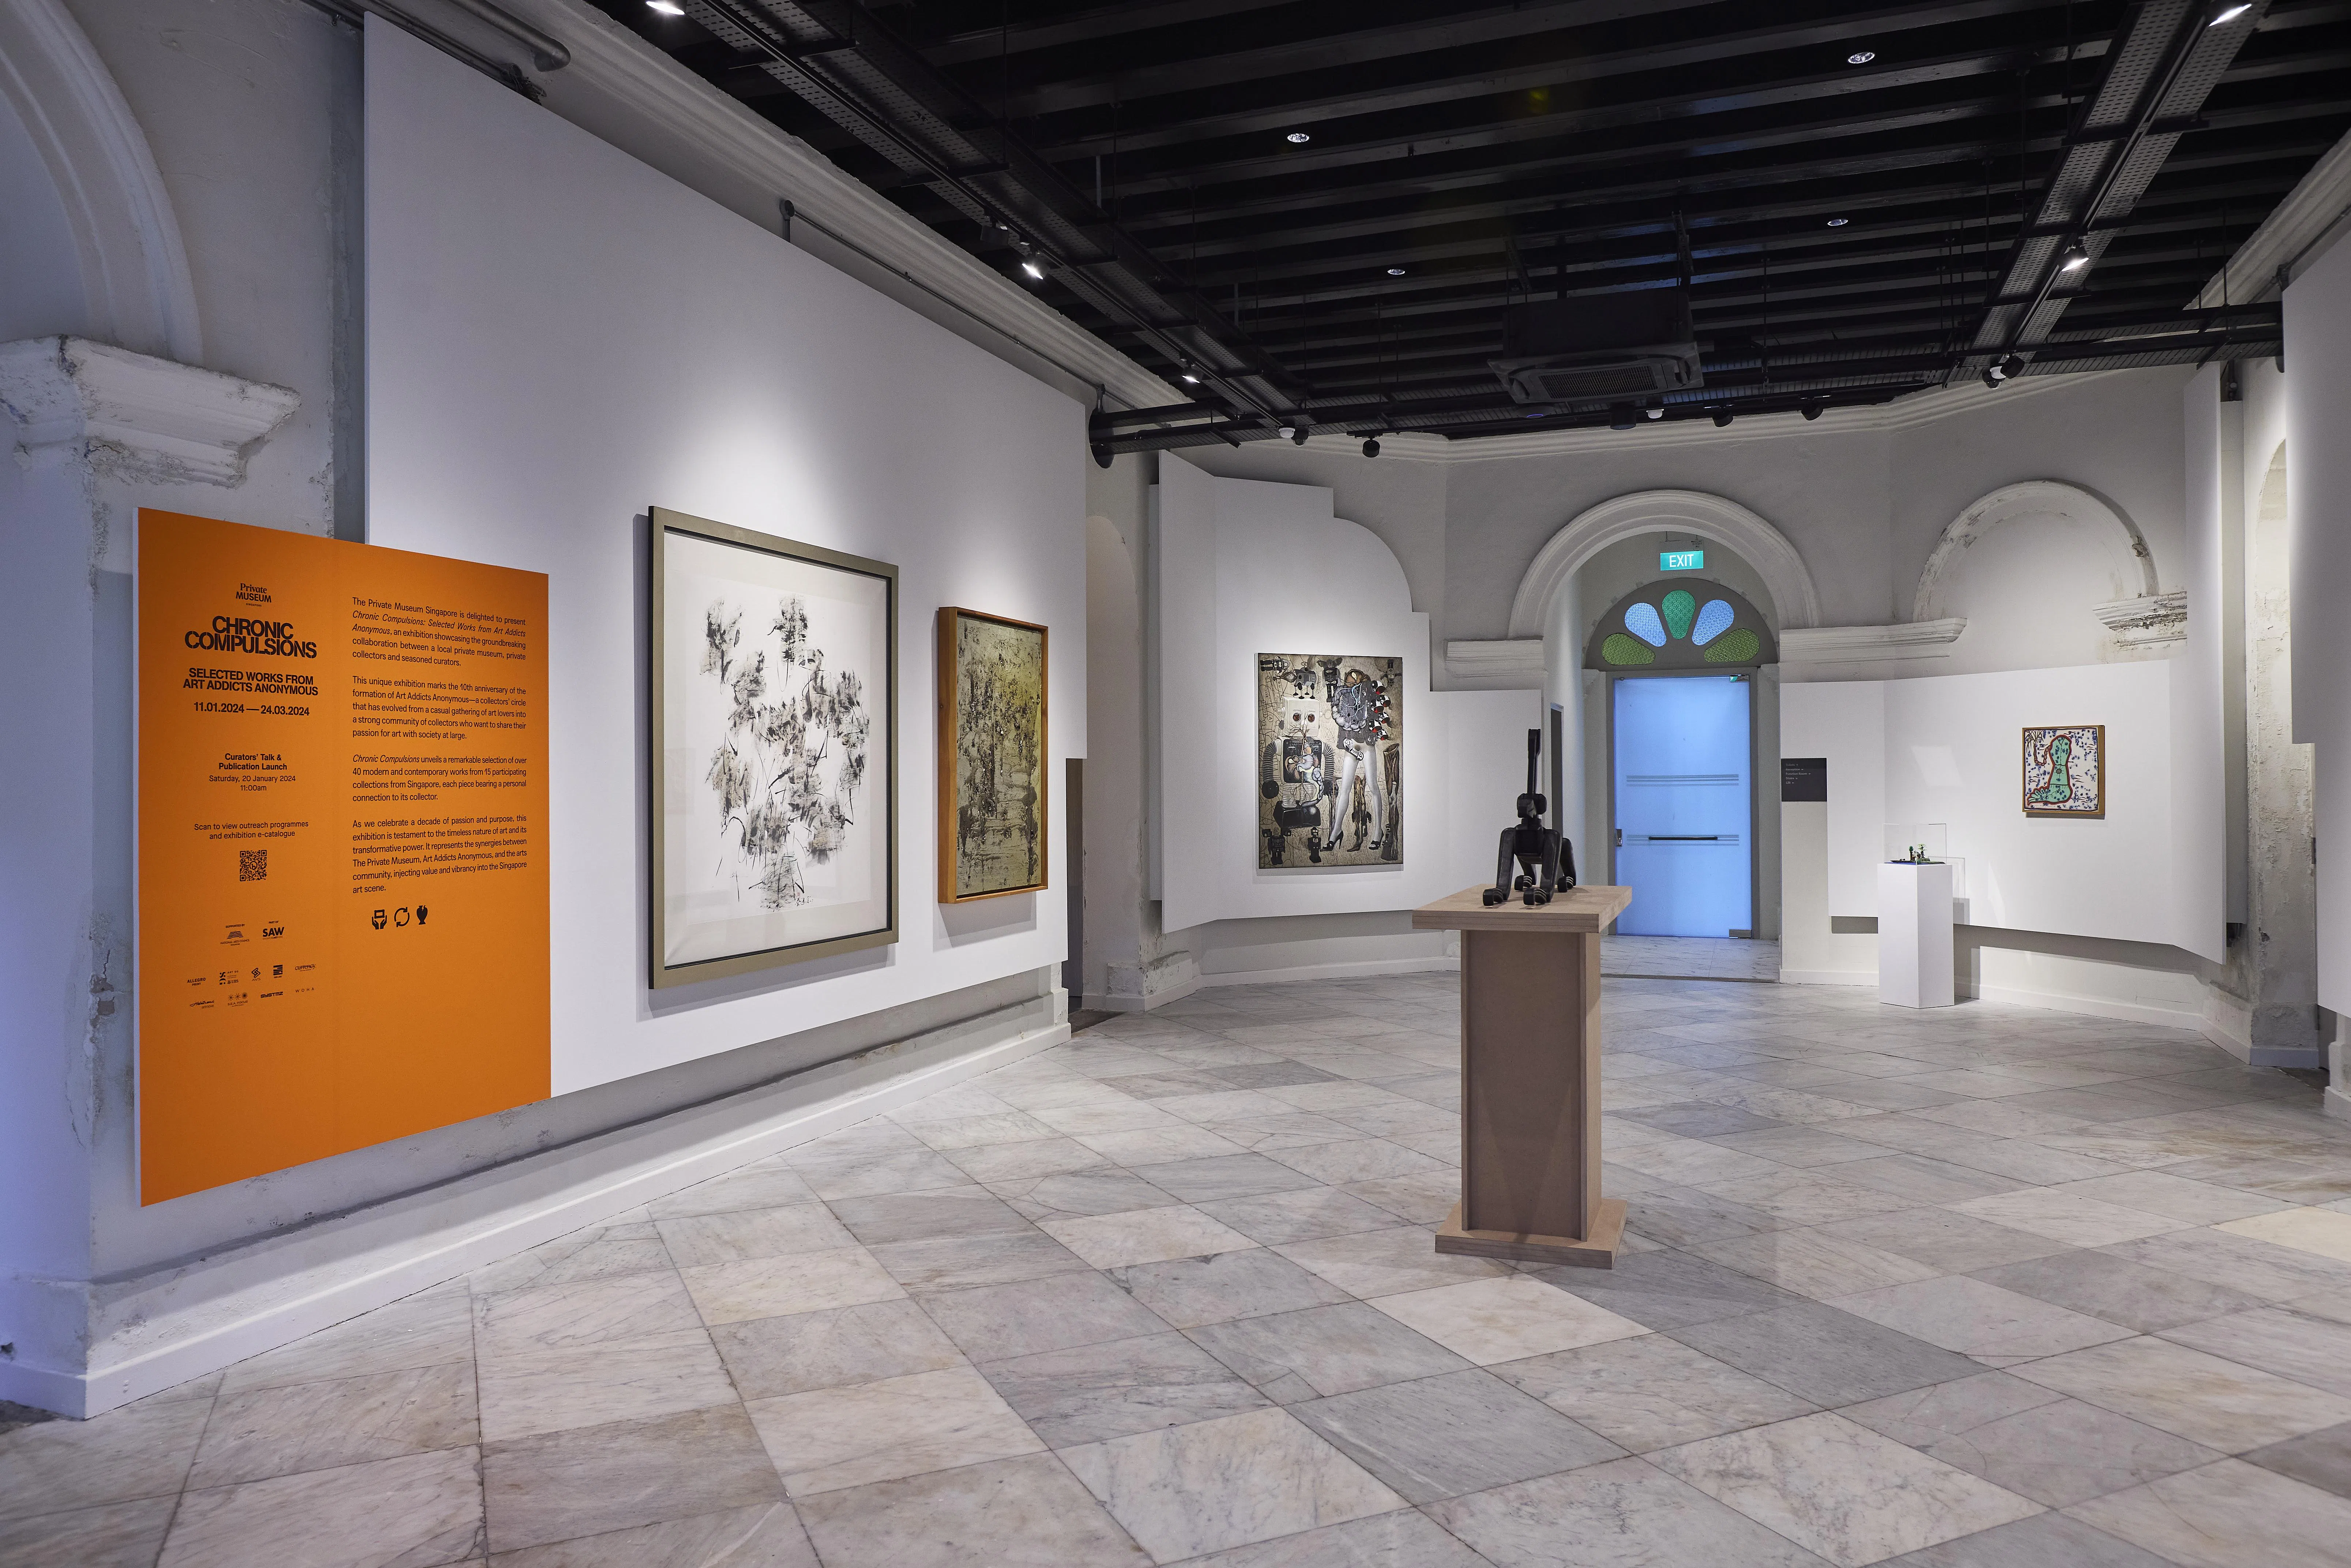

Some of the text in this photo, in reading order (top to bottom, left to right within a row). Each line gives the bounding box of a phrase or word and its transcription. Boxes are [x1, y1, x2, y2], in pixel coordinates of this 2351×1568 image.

[1669, 554, 1694, 567] EXIT
[240, 583, 267, 594] Private
[236, 591, 271, 603] MUSEUM
[352, 597, 365, 606] The
[369, 599, 392, 609] Private
[395, 602, 423, 613] Museum
[426, 606, 457, 617] Singapore
[467, 612, 494, 621] delighted
[212, 616, 293, 640] CHRONIC
[353, 610, 379, 620] Chronic
[383, 614, 425, 625] Compulsions:
[428, 619, 455, 629] Selected
[458, 623, 475, 631] Works
[505, 628, 526, 637] Addicts
[352, 624, 392, 635] Anonymous,
[403, 629, 433, 639] exhibition
[435, 632, 470, 644] showcasing
[482, 639, 526, 650] groundbreaking
[185, 631, 317, 658] COMPULSIONS
[353, 637, 398, 648] collaboration
[400, 641, 428, 651] between
[437, 645, 452, 653] local
[455, 647, 475, 655] private
[477, 650, 504, 658] museum,
[353, 650, 386, 659] collectors
[189, 668, 313, 685] SELECTED WORKS FROM
[183, 678, 318, 696] ART ADDICTS ANONYMOUS
[353, 676, 367, 684] This
[369, 678, 392, 687] unique
[394, 679, 425, 688] exhibition
[475, 685, 508, 695] anniversary
[353, 689, 386, 698] formation
[407, 692, 431, 700] Addicts
[194, 702, 244, 713] 11.01.2024
[261, 705, 310, 716] 24.03.2024
[380, 755, 420, 764] Compulsions
[209, 775, 240, 783] Saturday,
[452, 816, 474, 826] passion
[258, 830, 295, 838] e-catalogue
[353, 845, 401, 854] transformative
[403, 845, 424, 853] power.
[432, 842, 463, 851] represents
[475, 839, 501, 849] synergies
[367, 858, 390, 866] Private
[353, 871, 392, 880] community,
[394, 869, 420, 879] injecting
[439, 866, 450, 874] and
[500, 862, 527, 870] Singapore
[263, 927, 285, 937] SAW
